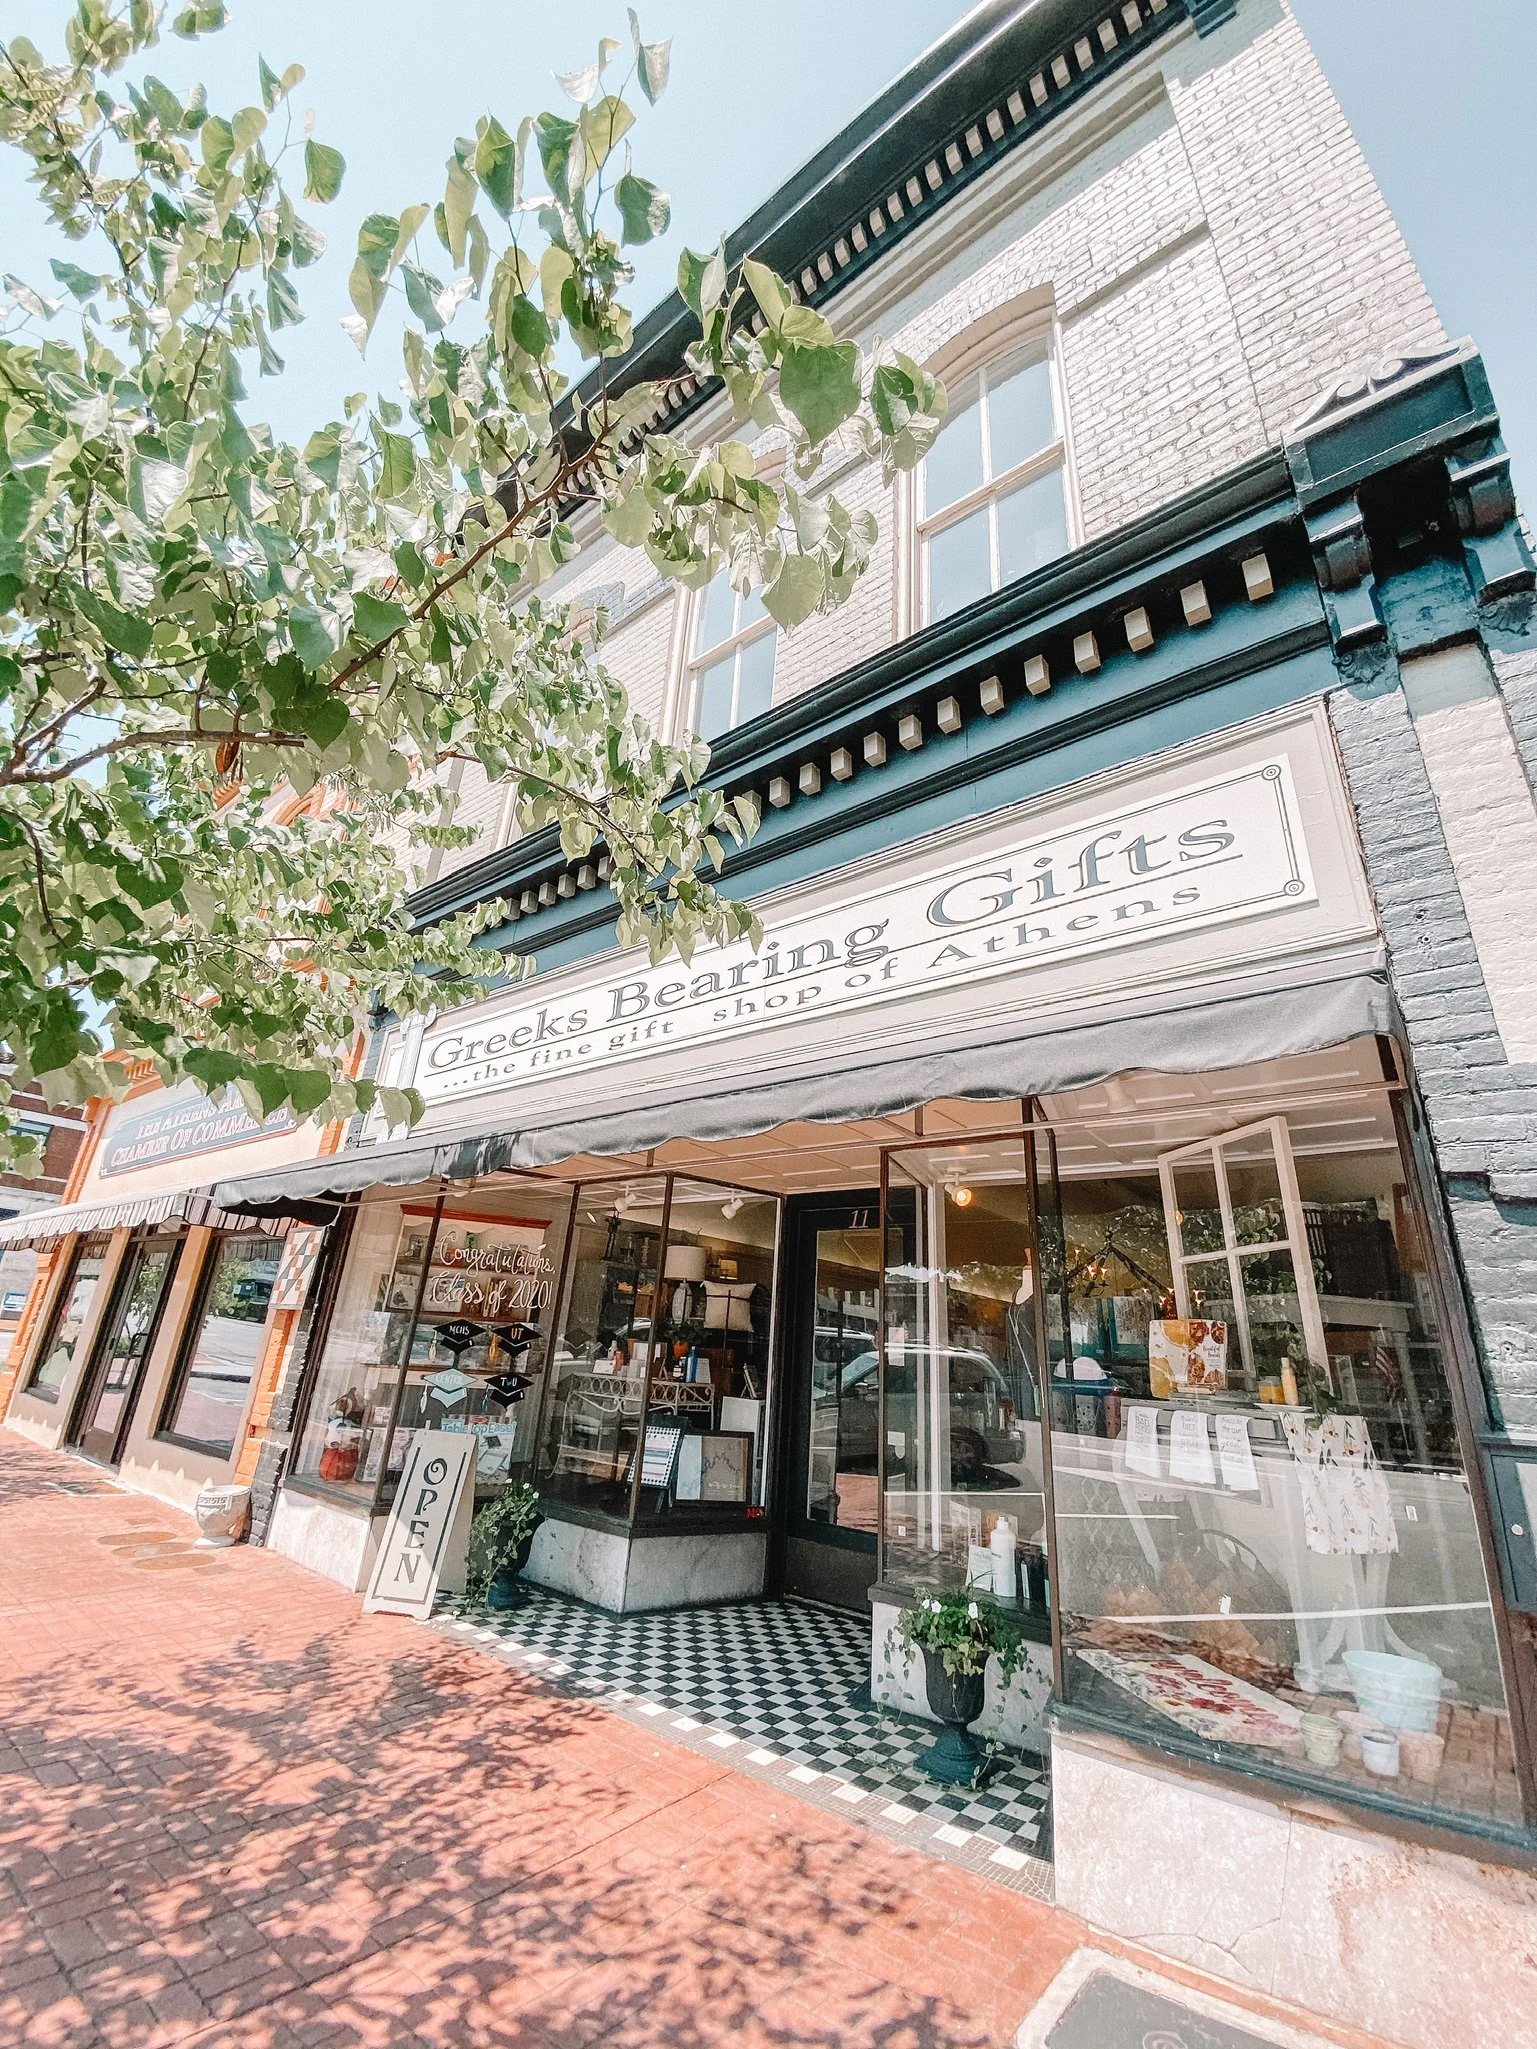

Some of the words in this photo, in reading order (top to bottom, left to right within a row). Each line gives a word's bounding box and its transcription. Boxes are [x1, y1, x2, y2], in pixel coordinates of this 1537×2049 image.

[427, 1008, 588, 1069] Greeks
[606, 917, 889, 1023] Bearing
[926, 819, 1235, 928] Gifts
[530, 1043, 592, 1068] fine
[608, 1019, 674, 1050] gift
[713, 985, 822, 1022] shop
[844, 957, 898, 987] of
[926, 887, 1201, 969] Athens
[111, 1135, 170, 1167] CHAMBER
[170, 1128, 193, 1150] OF
[192, 1107, 289, 1147] COMMECE
[848, 1209, 869, 1229] 11
[432, 1271, 485, 1304] Class
[488, 1280, 507, 1314] of
[509, 1279, 553, 1310] 2020!
[511, 1328, 524, 1340] UT
[393, 1457, 448, 1584] OPEN
